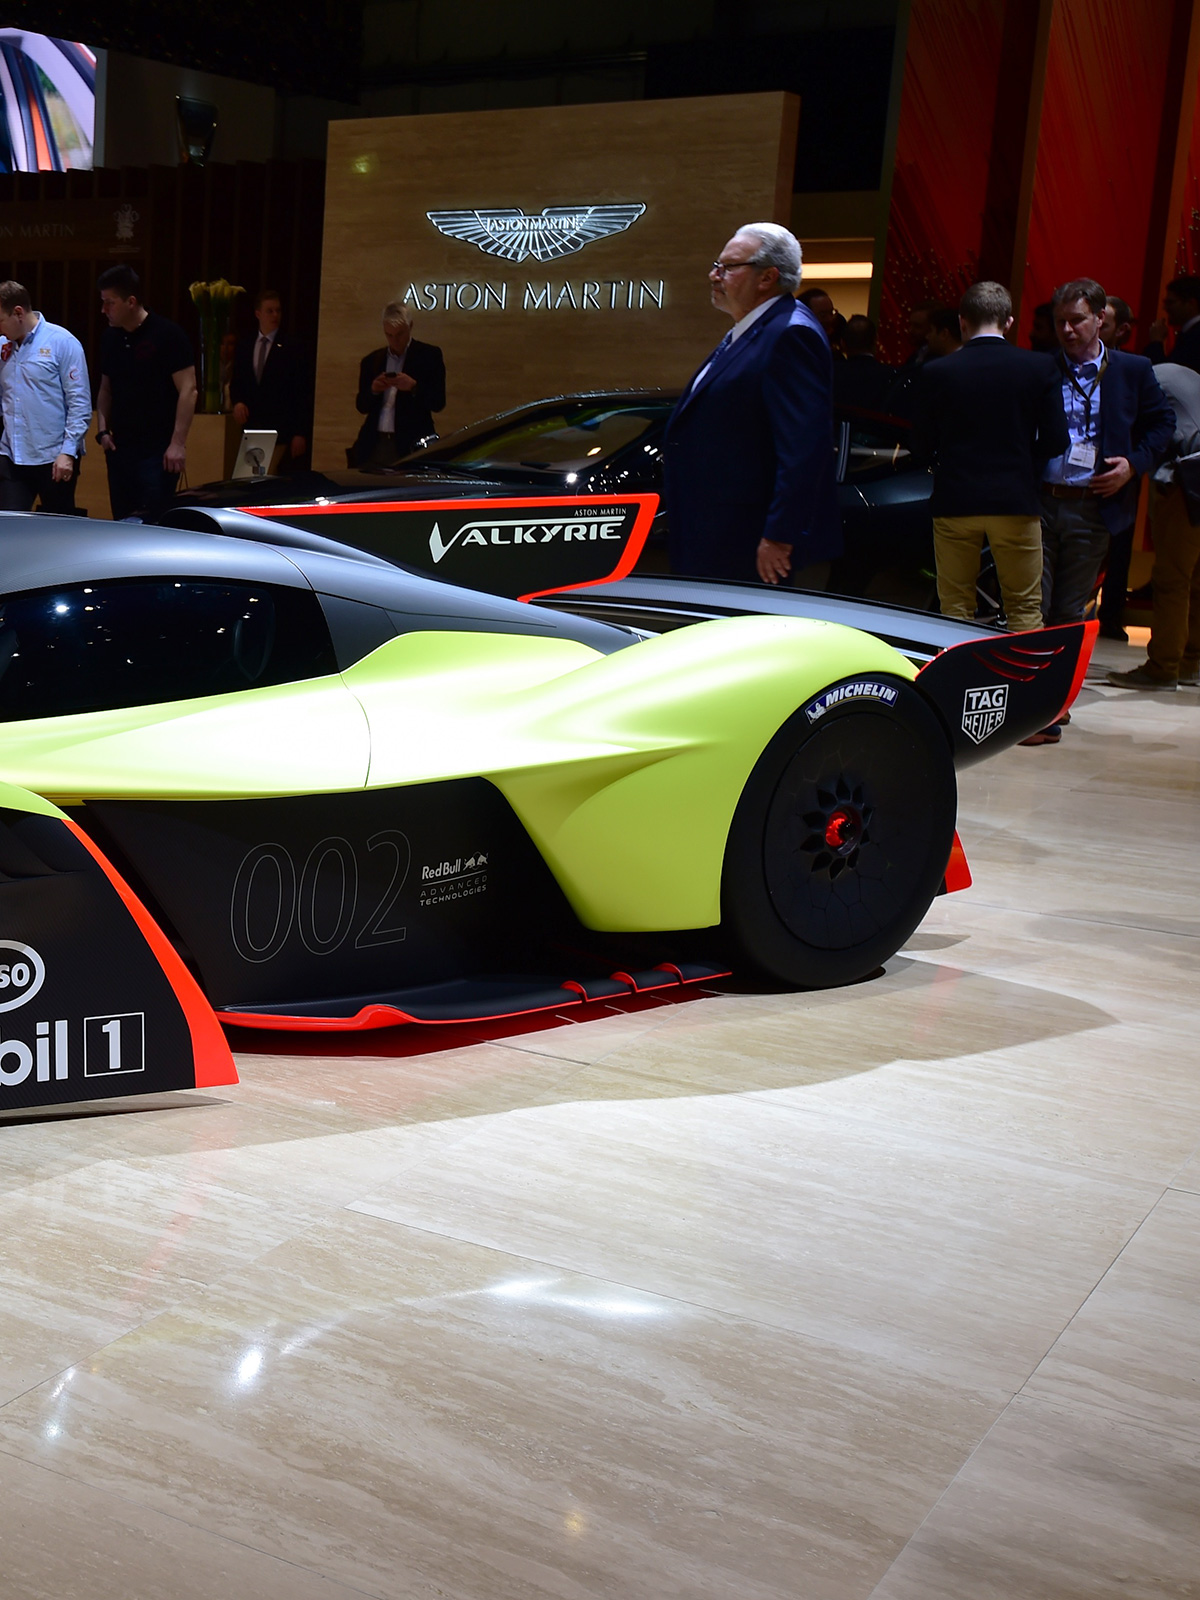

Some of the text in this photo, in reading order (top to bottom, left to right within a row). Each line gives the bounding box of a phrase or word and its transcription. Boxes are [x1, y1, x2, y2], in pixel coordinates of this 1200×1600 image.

[484, 216, 577, 232] ASTON MARTIN
[404, 279, 664, 311] ASTON MARTIN
[574, 507, 627, 517] ASTON MARTIN
[429, 521, 626, 564] VALKYRIE
[825, 683, 896, 708] MICHELIN
[969, 689, 1004, 710] TAG
[964, 711, 1003, 740] HEUER
[421, 858, 462, 880] Red Bull
[231, 830, 411, 963] 002
[420, 875, 488, 898] ADVANCED
[420, 884, 487, 907] TECHNOLOGIES
[102, 1019, 121, 1070] 1
